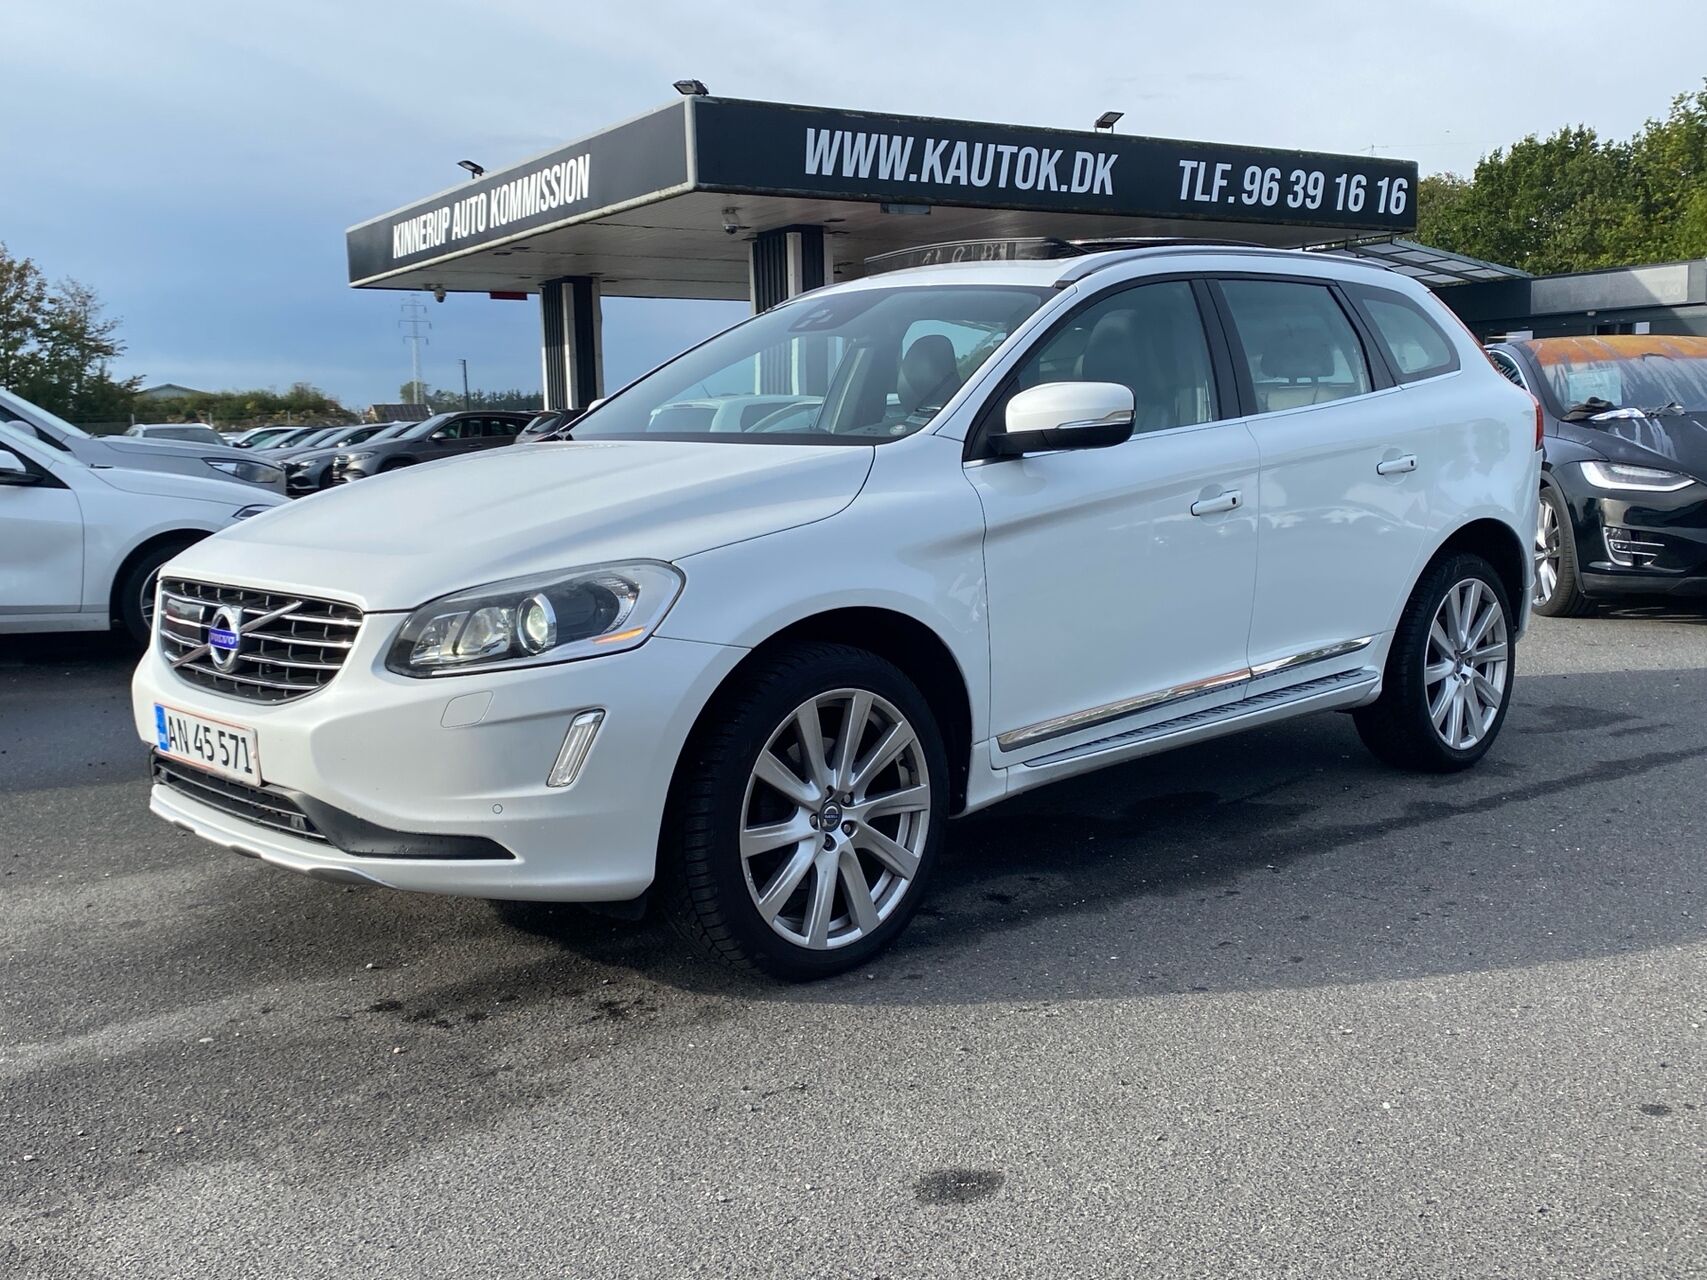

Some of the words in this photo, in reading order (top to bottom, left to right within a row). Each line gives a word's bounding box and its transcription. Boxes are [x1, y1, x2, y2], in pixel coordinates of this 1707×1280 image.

[805, 128, 1118, 195] WWW.KAUTOK.DK
[1179, 160, 1234, 203] TLF.
[1241, 165, 1282, 207] 96
[1287, 169, 1325, 210] 39
[1335, 173, 1368, 212] 16
[1377, 176, 1409, 215] 16
[392, 206, 451, 259] KINNERUP
[451, 192, 487, 241] AUTO
[490, 154, 590, 228] KOMMISSION
[168, 716, 189, 754] AN
[194, 724, 214, 761] 45
[218, 730, 252, 774] 571
